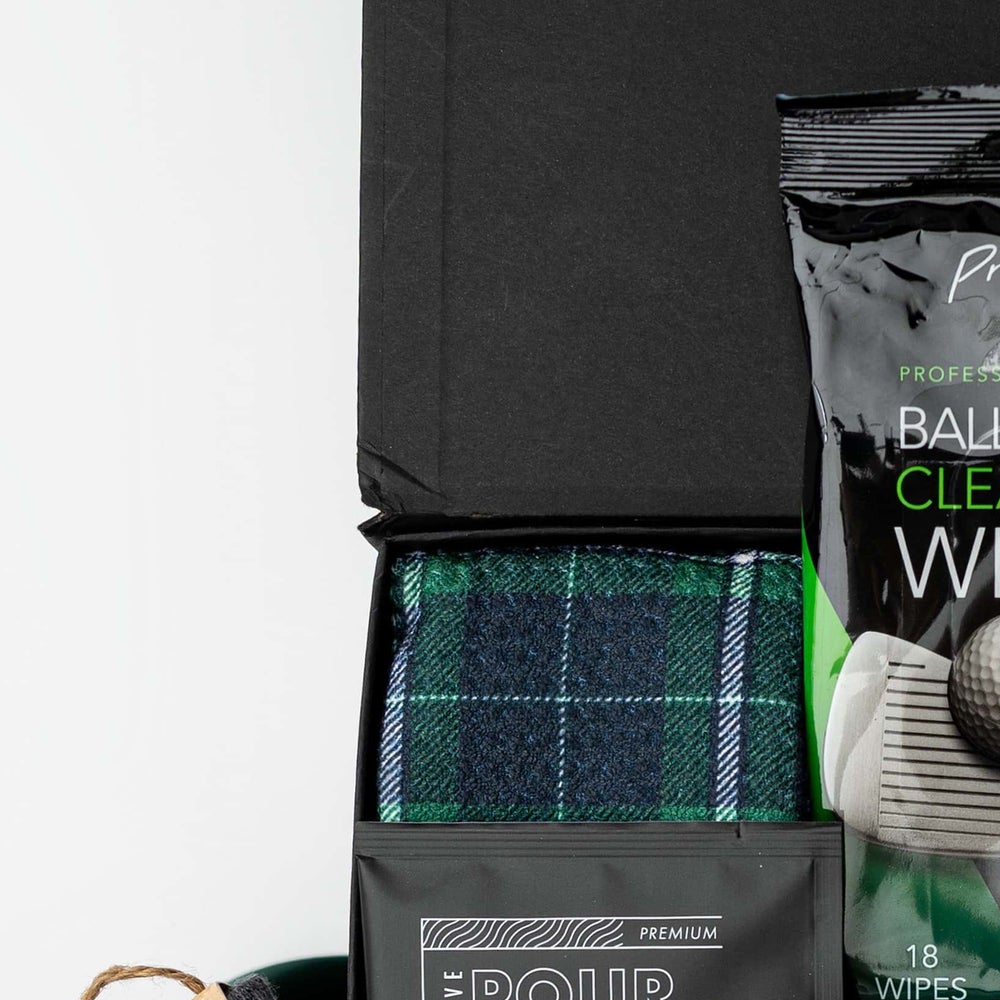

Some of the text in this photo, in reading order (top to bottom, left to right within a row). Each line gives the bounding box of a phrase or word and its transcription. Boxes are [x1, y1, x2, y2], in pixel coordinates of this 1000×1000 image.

[639, 926, 719, 941] PREMIUM
[905, 944, 939, 969] 18
[875, 977, 967, 1000] WIPES
